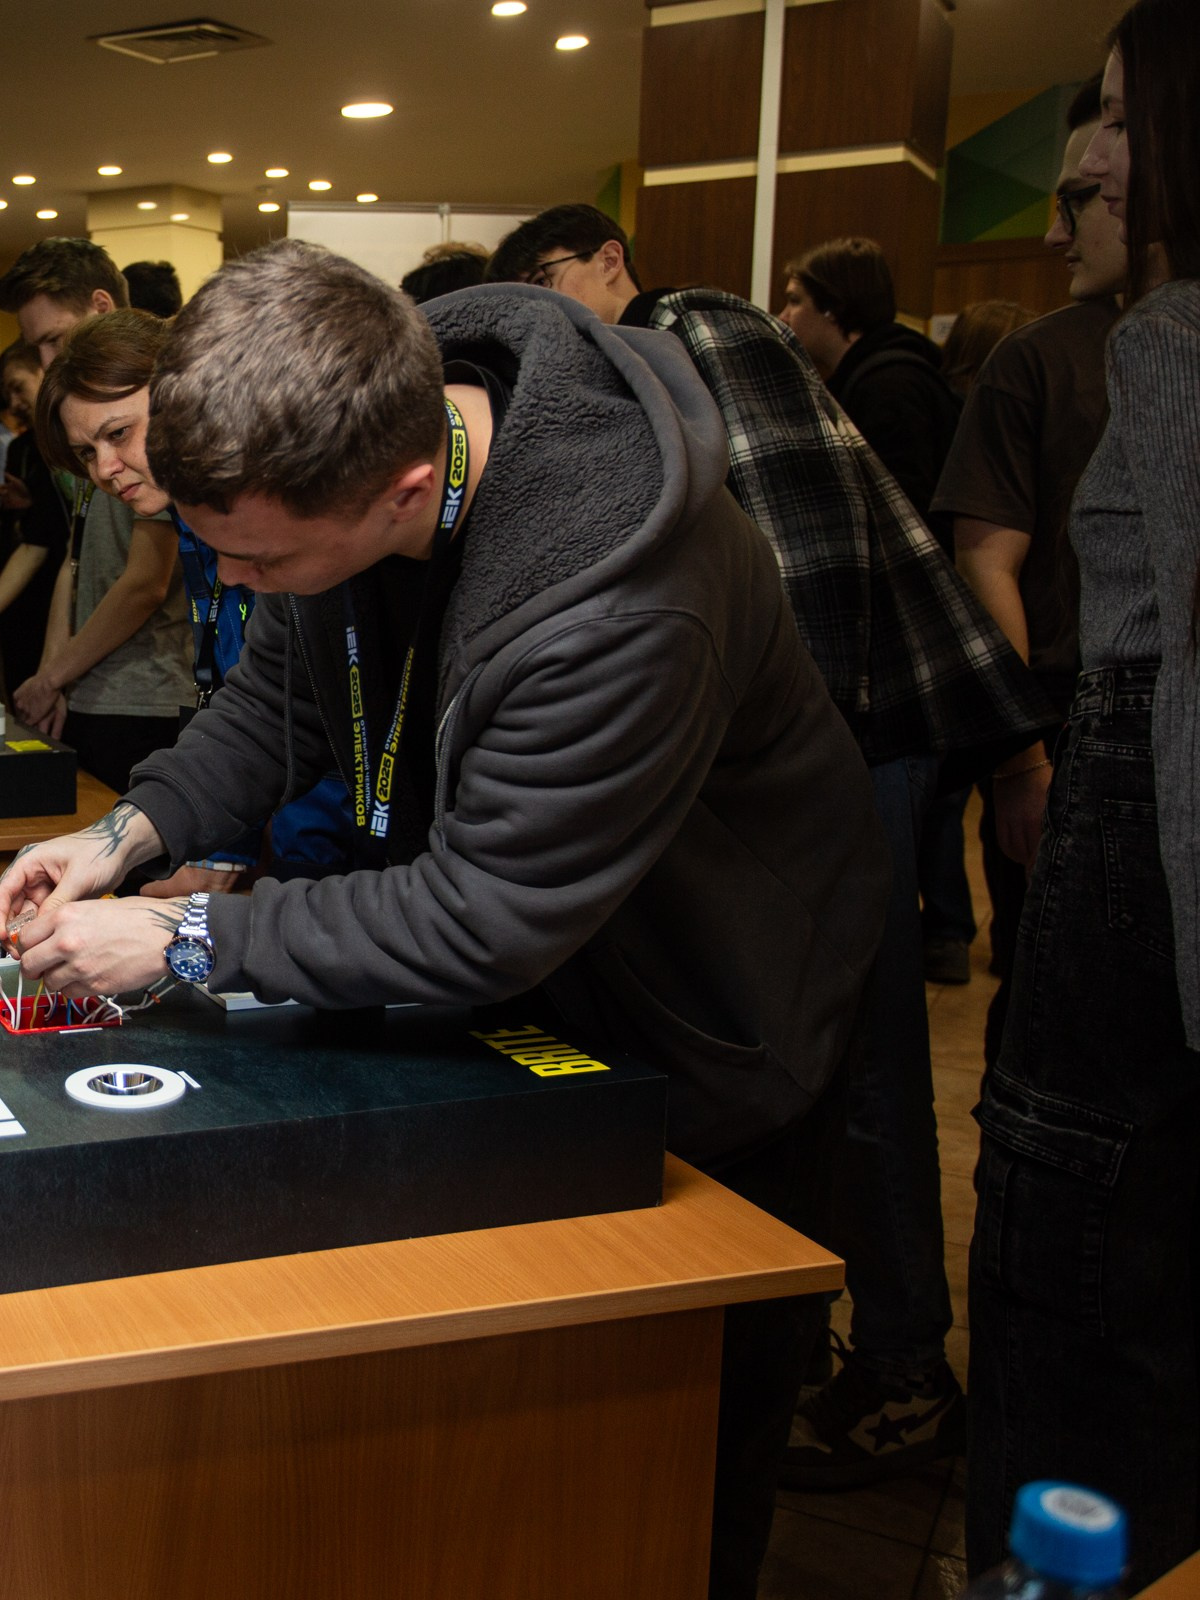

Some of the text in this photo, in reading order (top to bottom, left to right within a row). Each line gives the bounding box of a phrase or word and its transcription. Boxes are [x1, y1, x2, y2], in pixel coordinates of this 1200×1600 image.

[452, 433, 464, 482] 2025
[351, 671, 362, 716] 2025
[359, 719, 373, 774] ОТКРЫТЫЙ
[352, 722, 366, 828] ЭЛЕКТРИКОВ
[379, 758, 392, 799] 2025
[467, 1024, 612, 1078] BRITE
